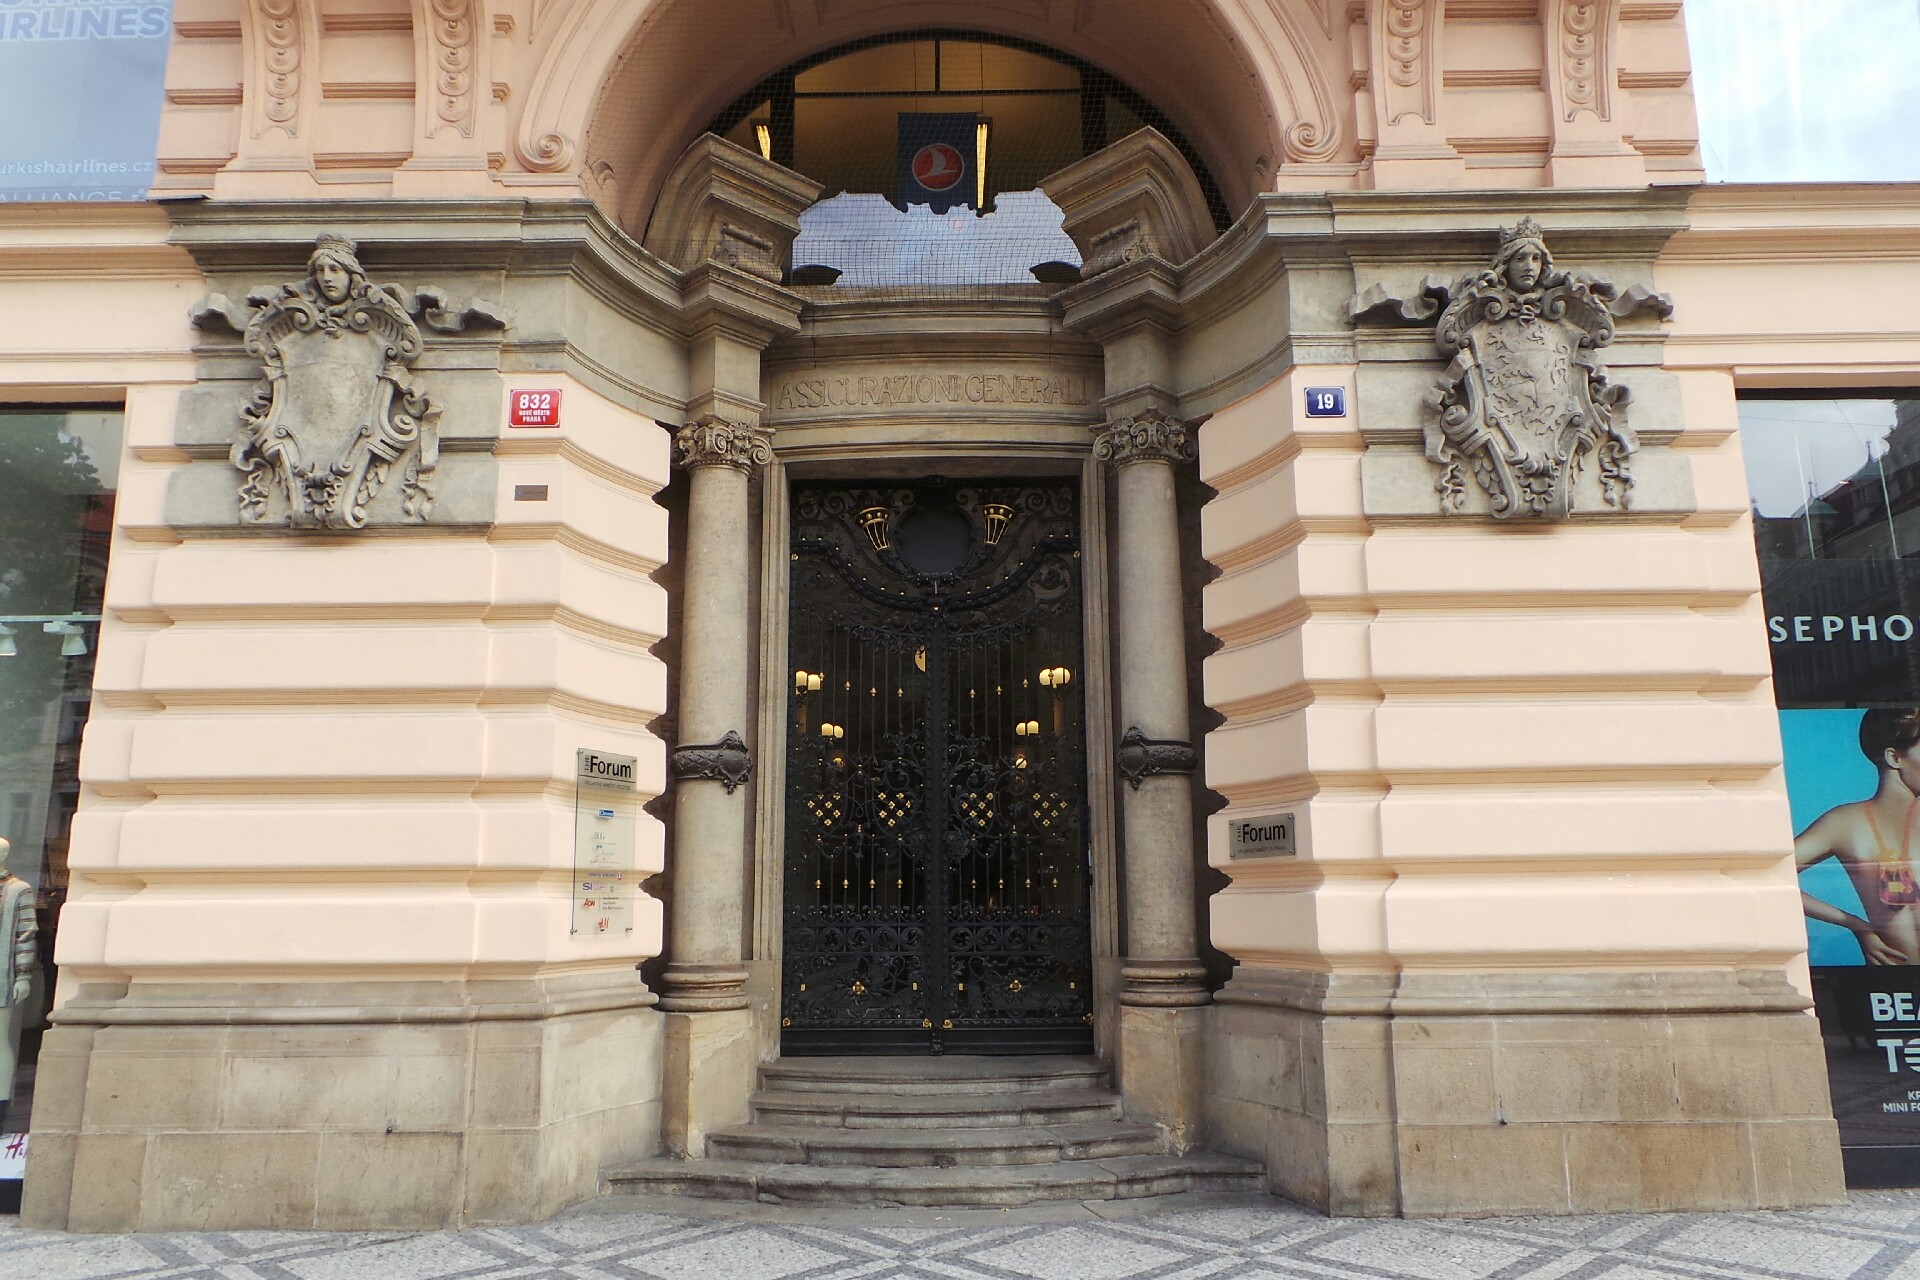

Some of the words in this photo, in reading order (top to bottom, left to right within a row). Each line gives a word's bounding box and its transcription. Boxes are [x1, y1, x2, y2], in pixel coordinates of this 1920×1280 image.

[777, 374, 958, 409] ASSICURAZIONI
[965, 374, 1090, 406] GENERALI
[519, 393, 551, 409] 832
[1317, 393, 1334, 409] 19
[590, 755, 632, 779] Forum
[1242, 824, 1286, 844] Forum
[1883, 1102, 1908, 1113] MINI
